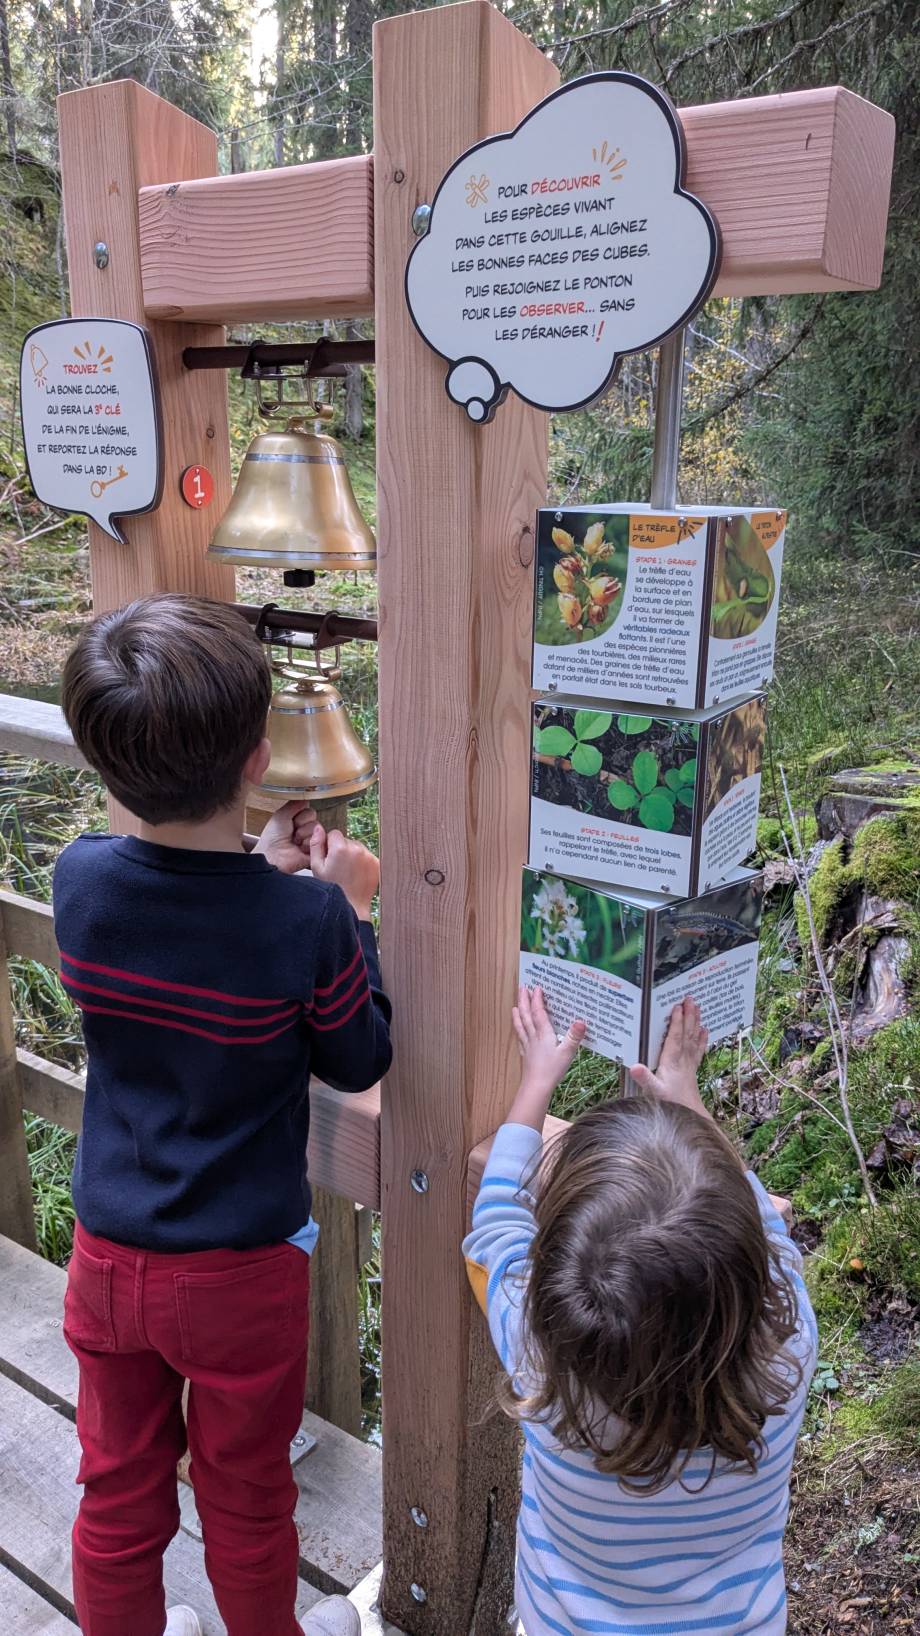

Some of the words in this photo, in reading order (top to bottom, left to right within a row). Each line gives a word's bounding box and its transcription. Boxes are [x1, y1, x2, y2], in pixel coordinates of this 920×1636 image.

[498, 184, 528, 198] POUR
[531, 174, 600, 194] DÉCOUVRIR
[484, 210, 508, 223] LES
[511, 203, 570, 221] ESPÈCES
[574, 197, 615, 212] VIVANT
[455, 236, 485, 250] DANS
[488, 232, 527, 247] CETTE
[531, 227, 587, 243] GOUILLE,
[590, 219, 647, 237] ALIGNEZ
[451, 260, 474, 272] LES
[477, 255, 525, 270] BONNES
[528, 251, 568, 266] FACES
[572, 249, 599, 262] DES
[603, 244, 650, 259] CUBES.
[465, 285, 489, 298] PUIS
[493, 280, 560, 296] REJOIGNEZ
[564, 278, 580, 291] LE
[584, 274, 633, 289] PONTON
[462, 308, 490, 320] POUR
[493, 306, 516, 318] LES
[599, 298, 635, 312] SANS
[495, 328, 518, 340] LES
[522, 324, 589, 339] DÉRANGER
[63, 364, 98, 374] TROUVEZ
[46, 385, 57, 394] LA
[58, 385, 83, 394] BONNE
[85, 385, 119, 396] CLOCHE,
[47, 405, 59, 415] QUI
[61, 405, 81, 414] SERA
[83, 405, 93, 414] LA
[105, 403, 121, 414] CLÉ
[42, 425, 53, 434] DE
[54, 425, 64, 434] LA
[65, 425, 77, 434] FIN
[79, 425, 90, 435] DE
[92, 424, 129, 437] L'ÉNIGME,
[37, 445, 47, 453] ET
[49, 445, 86, 455] REPORTEZ
[89, 445, 99, 455] LA
[101, 444, 137, 456] RÉPONSE
[63, 464, 83, 473] DANS
[85, 465, 94, 474] LA
[97, 466, 107, 474] BD
[109, 466, 111, 475] !
[193, 476, 205, 498] 1
[646, 523, 676, 532] TRÈFLE
[632, 534, 654, 542] D'EAU
[646, 577, 686, 586] développe
[644, 587, 671, 595] surface
[633, 594, 661, 604] bordure
[675, 599, 692, 607] plan
[665, 608, 694, 616] lesquels
[649, 617, 672, 625] former
[623, 624, 657, 633] véritables
[659, 628, 690, 636] radeaux
[578, 647, 590, 655] des
[628, 653, 640, 661] des
[604, 641, 616, 649] des
[618, 643, 647, 652] espèces
[649, 646, 686, 656] pionnières
[590, 658, 603, 666] Des
[605, 660, 630, 669] graines
[632, 663, 642, 671] de
[543, 662, 565, 671] datant
[577, 666, 599, 676] milliers
[635, 673, 650, 681] sont
[651, 674, 689, 685] retrouvées
[562, 674, 583, 684] parfait
[585, 676, 598, 684] état
[600, 678, 616, 686] dans
[618, 680, 628, 688] les
[629, 681, 642, 689] sols
